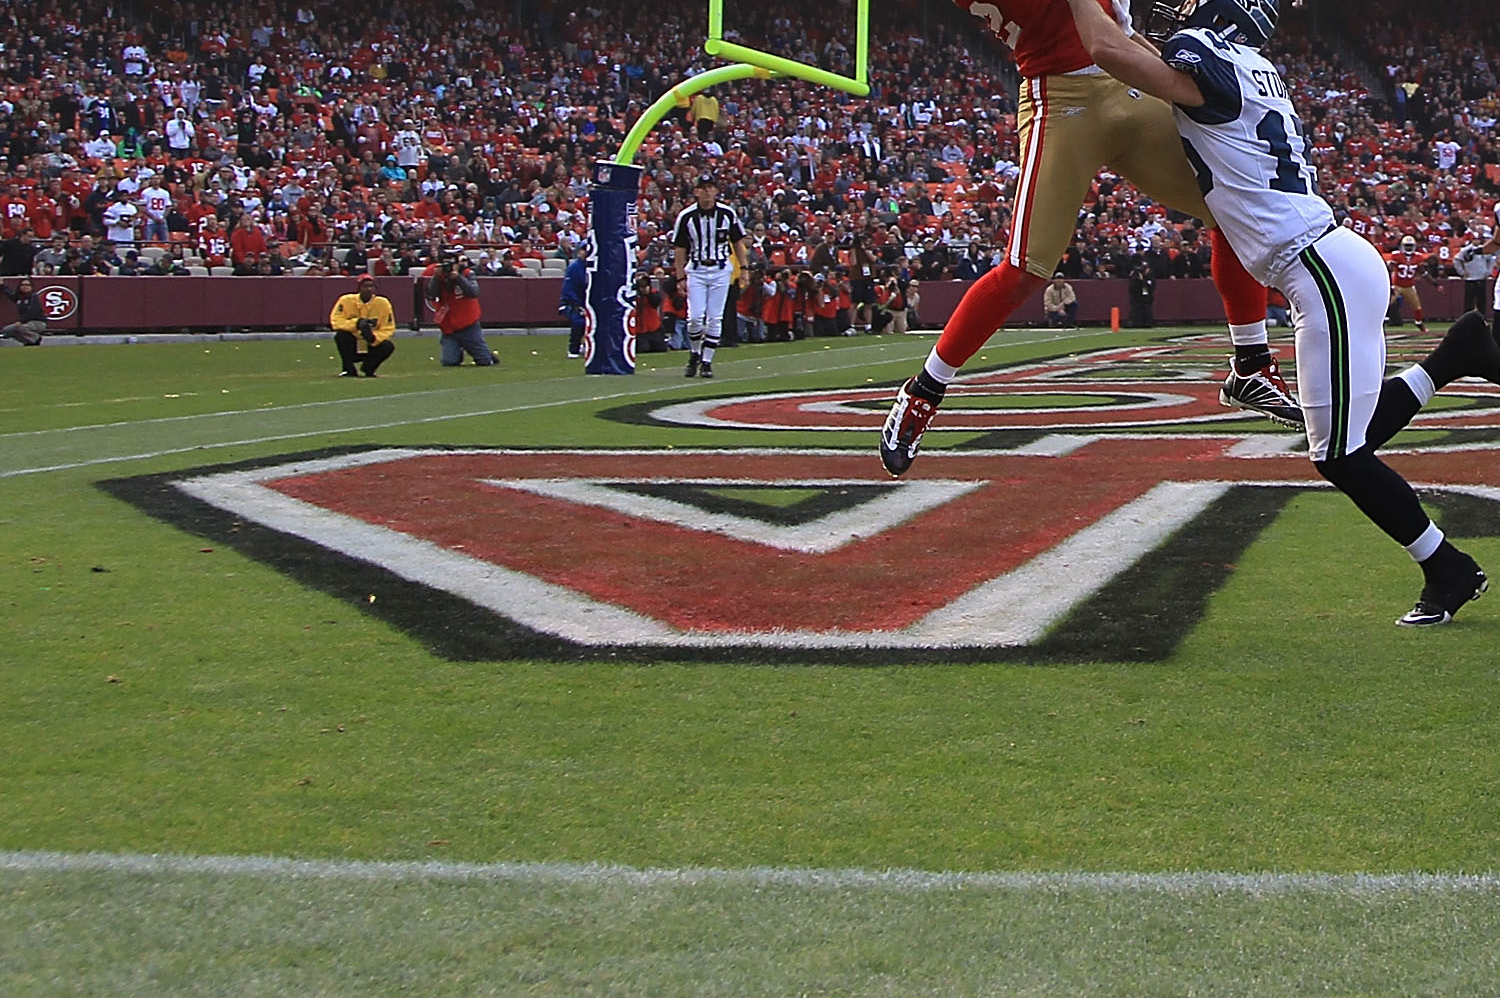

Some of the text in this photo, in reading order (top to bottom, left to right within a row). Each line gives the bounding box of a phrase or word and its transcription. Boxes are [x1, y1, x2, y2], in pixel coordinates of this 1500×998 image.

[1252, 69, 1289, 101] STO
[796, 246, 808, 261] 4
[1439, 246, 1450, 260] 8
[1397, 264, 1418, 279] 35
